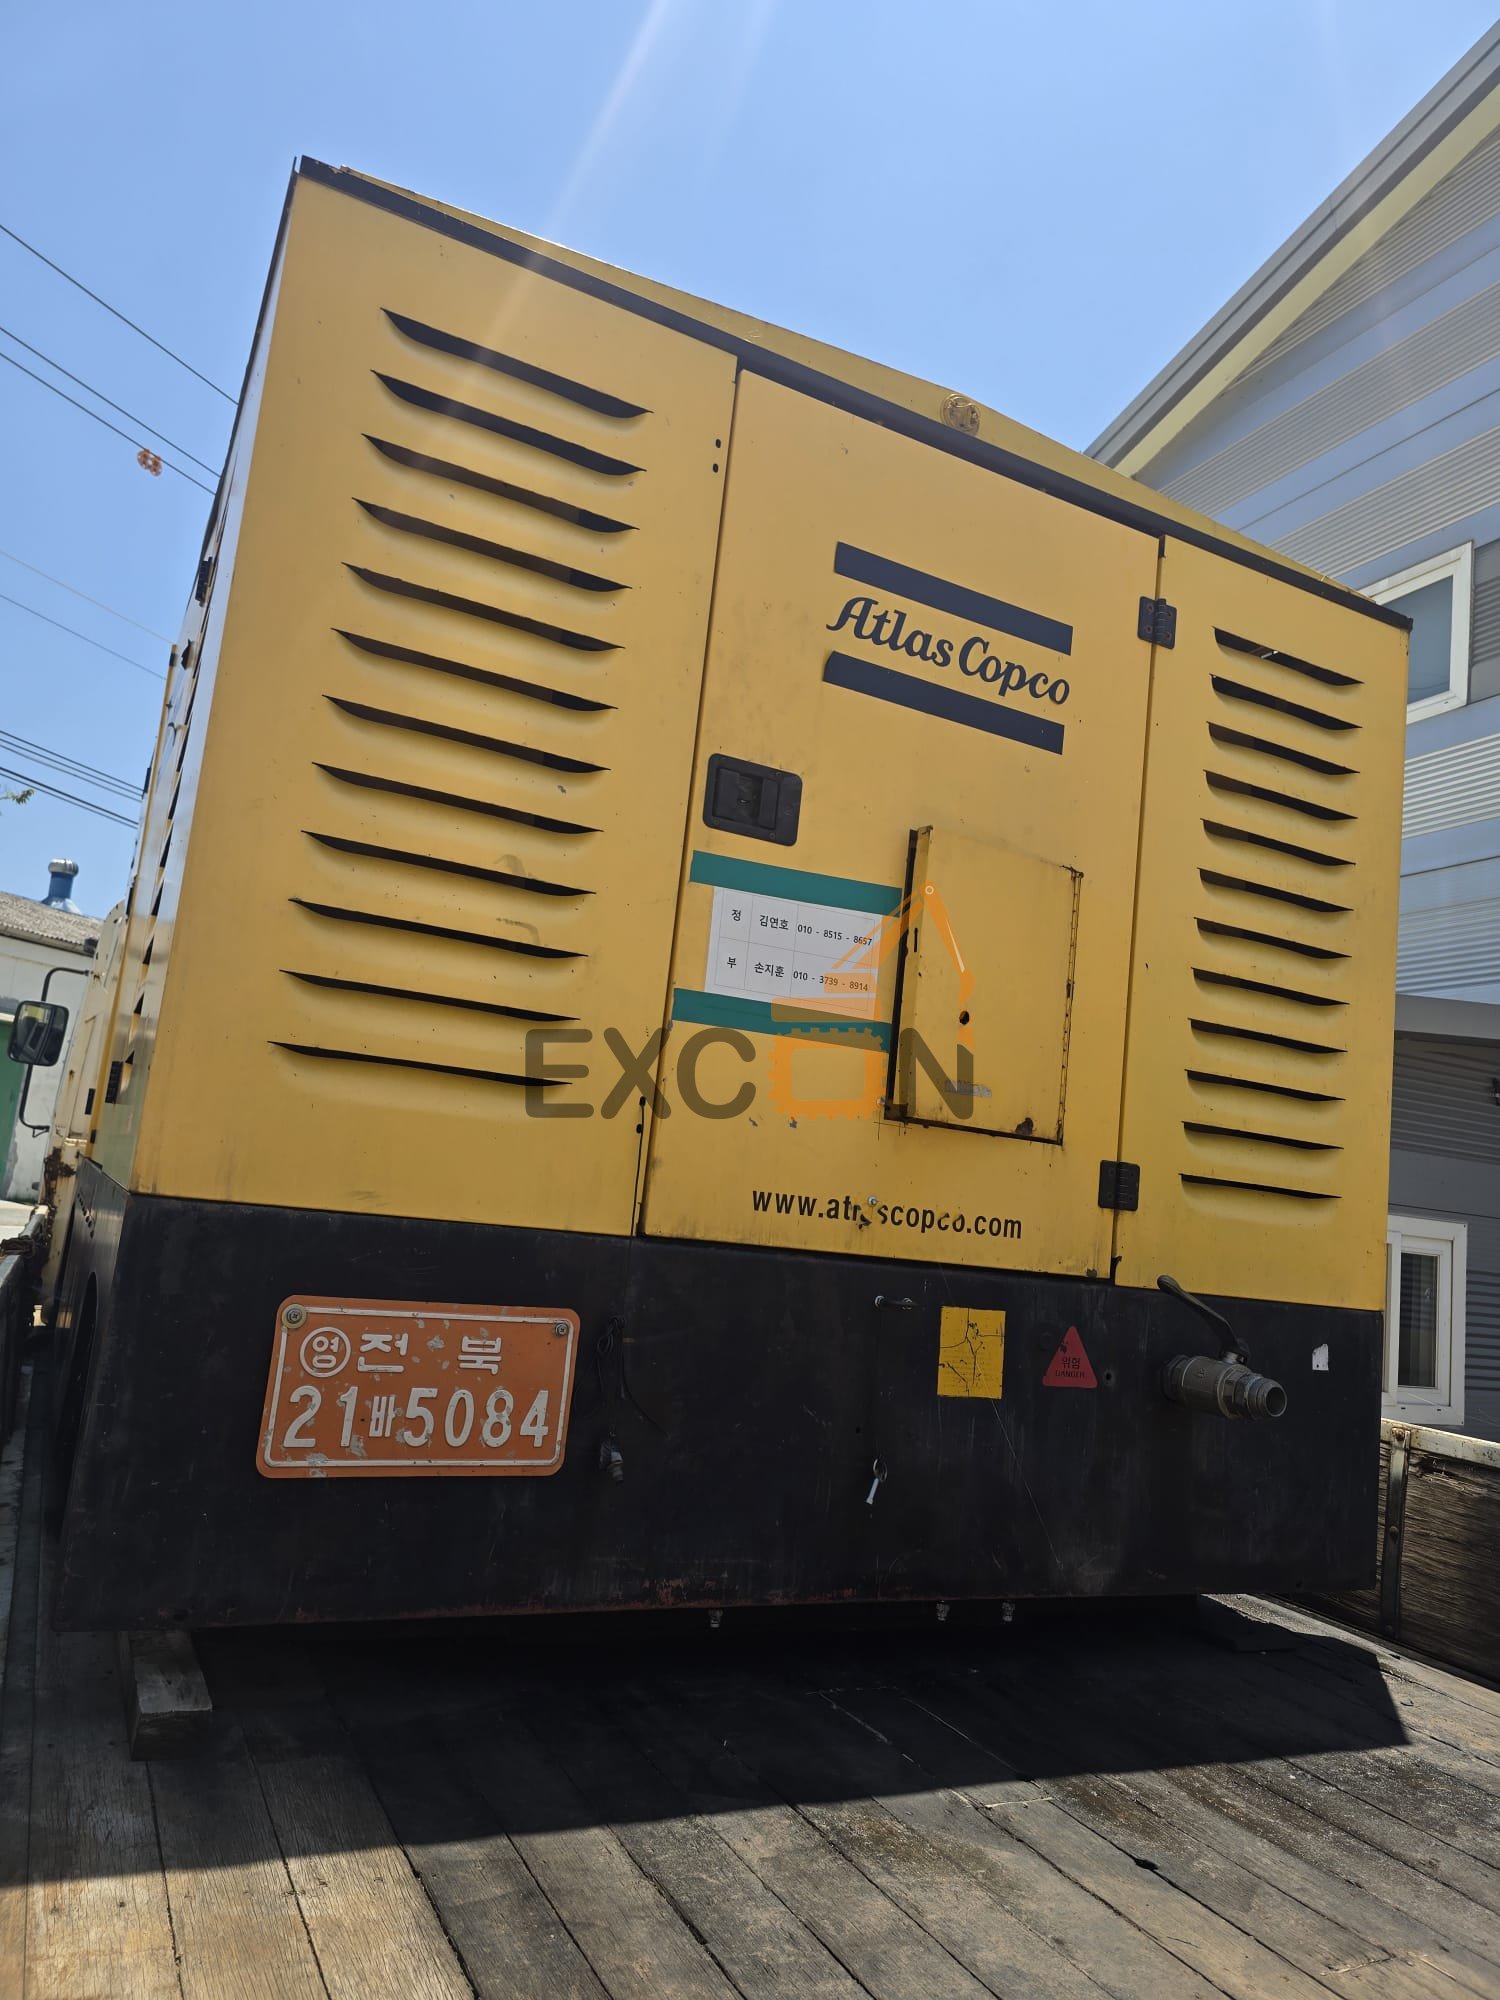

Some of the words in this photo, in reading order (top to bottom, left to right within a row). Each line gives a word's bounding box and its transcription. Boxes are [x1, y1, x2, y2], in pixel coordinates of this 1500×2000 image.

[826, 597, 954, 667] Atlas
[959, 636, 1070, 705] Copco
[731, 909, 742, 922] 정
[759, 914, 789, 931] 김연호
[797, 924, 813, 935] 010
[823, 929, 843, 941] 8515
[853, 935, 873, 946] 8657
[727, 956, 737, 968] 부
[754, 962, 785, 977] 손지훈
[793, 971, 808, 981] 010
[819, 975, 839, 986] 3739
[849, 981, 868, 992] 8914
[1061, 1356, 1080, 1370] 위험
